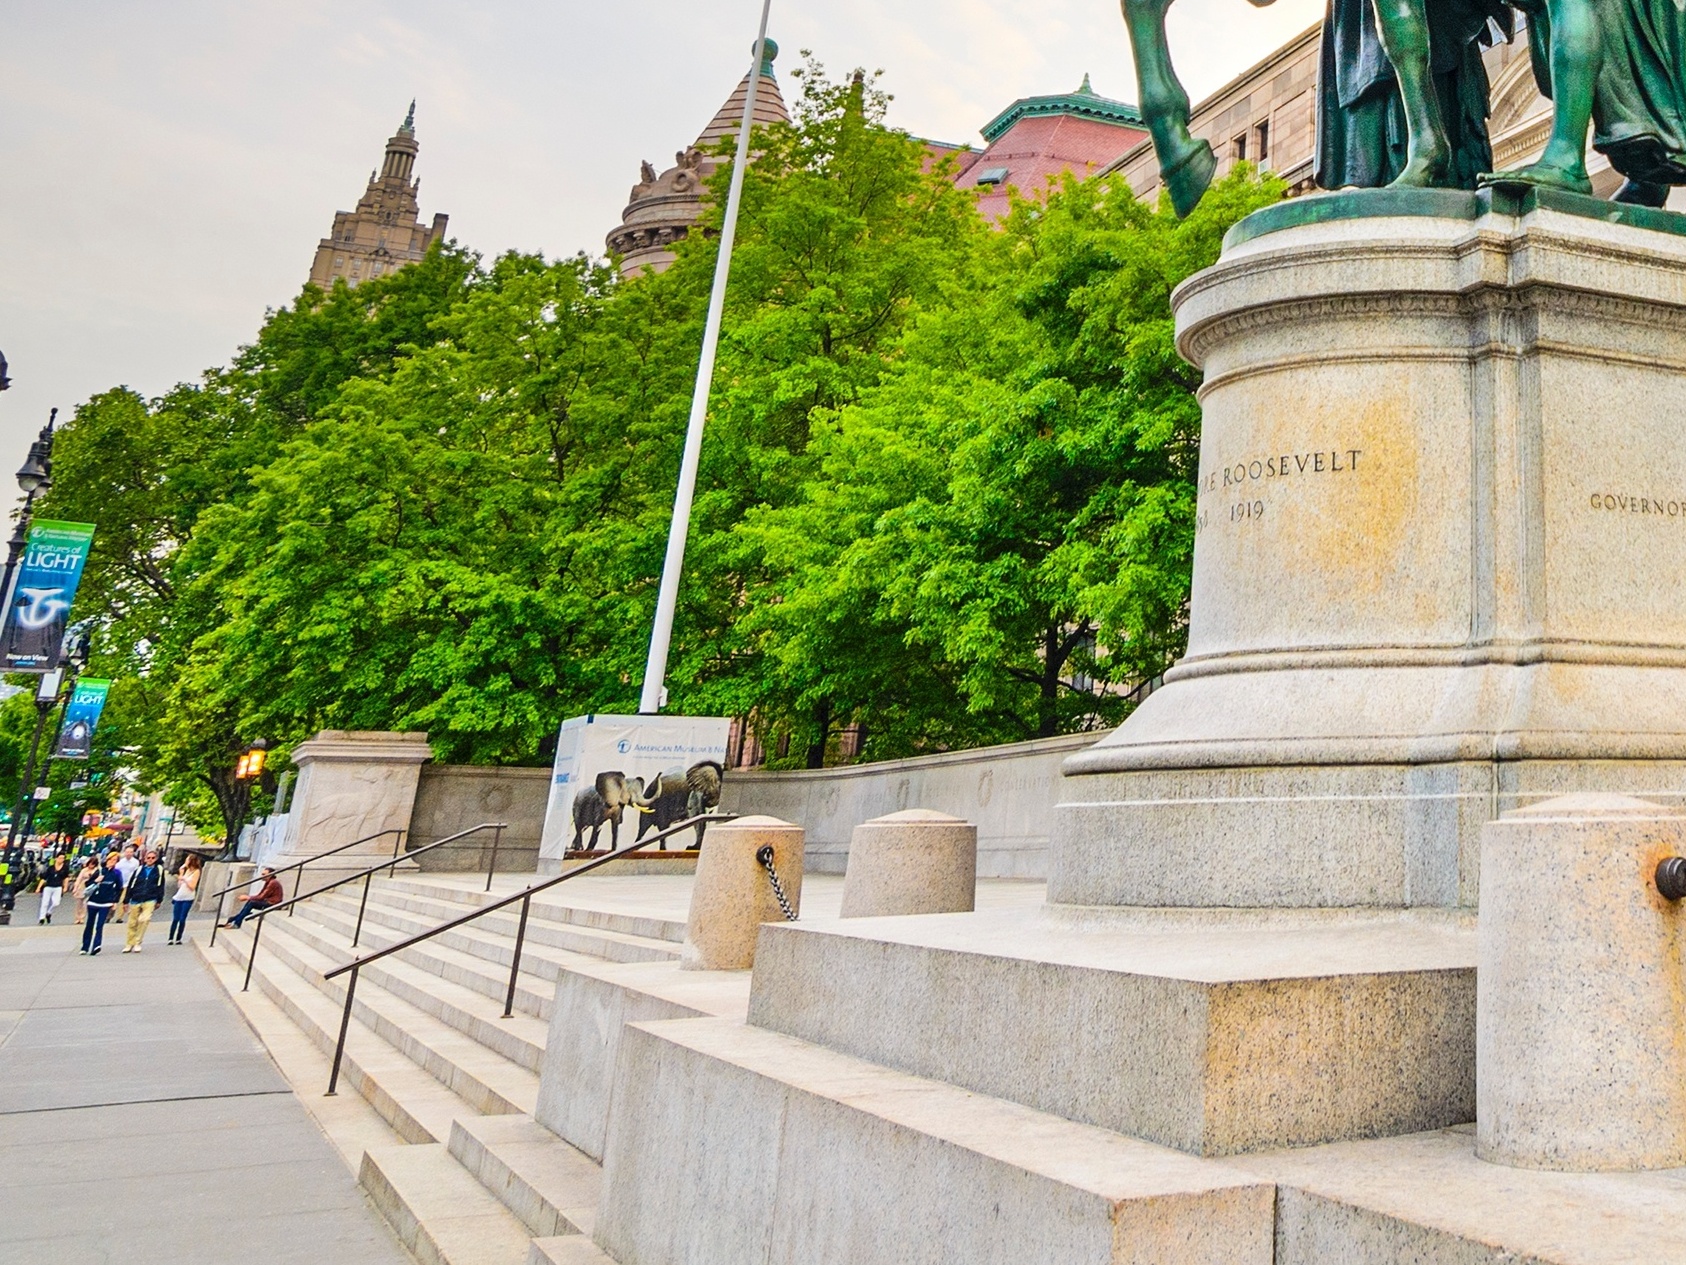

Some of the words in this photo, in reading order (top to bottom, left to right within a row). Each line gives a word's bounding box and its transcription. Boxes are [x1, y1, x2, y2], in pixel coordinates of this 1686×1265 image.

[1222, 450, 1362, 487] ROOSEVELT
[1230, 500, 1265, 522] 1919
[31, 542, 70, 554] Creatures
[71, 545, 83, 555] of
[26, 552, 83, 570] LIGHT
[74, 695, 104, 705] LIGHT
[634, 744, 672, 753] AMERICAN
